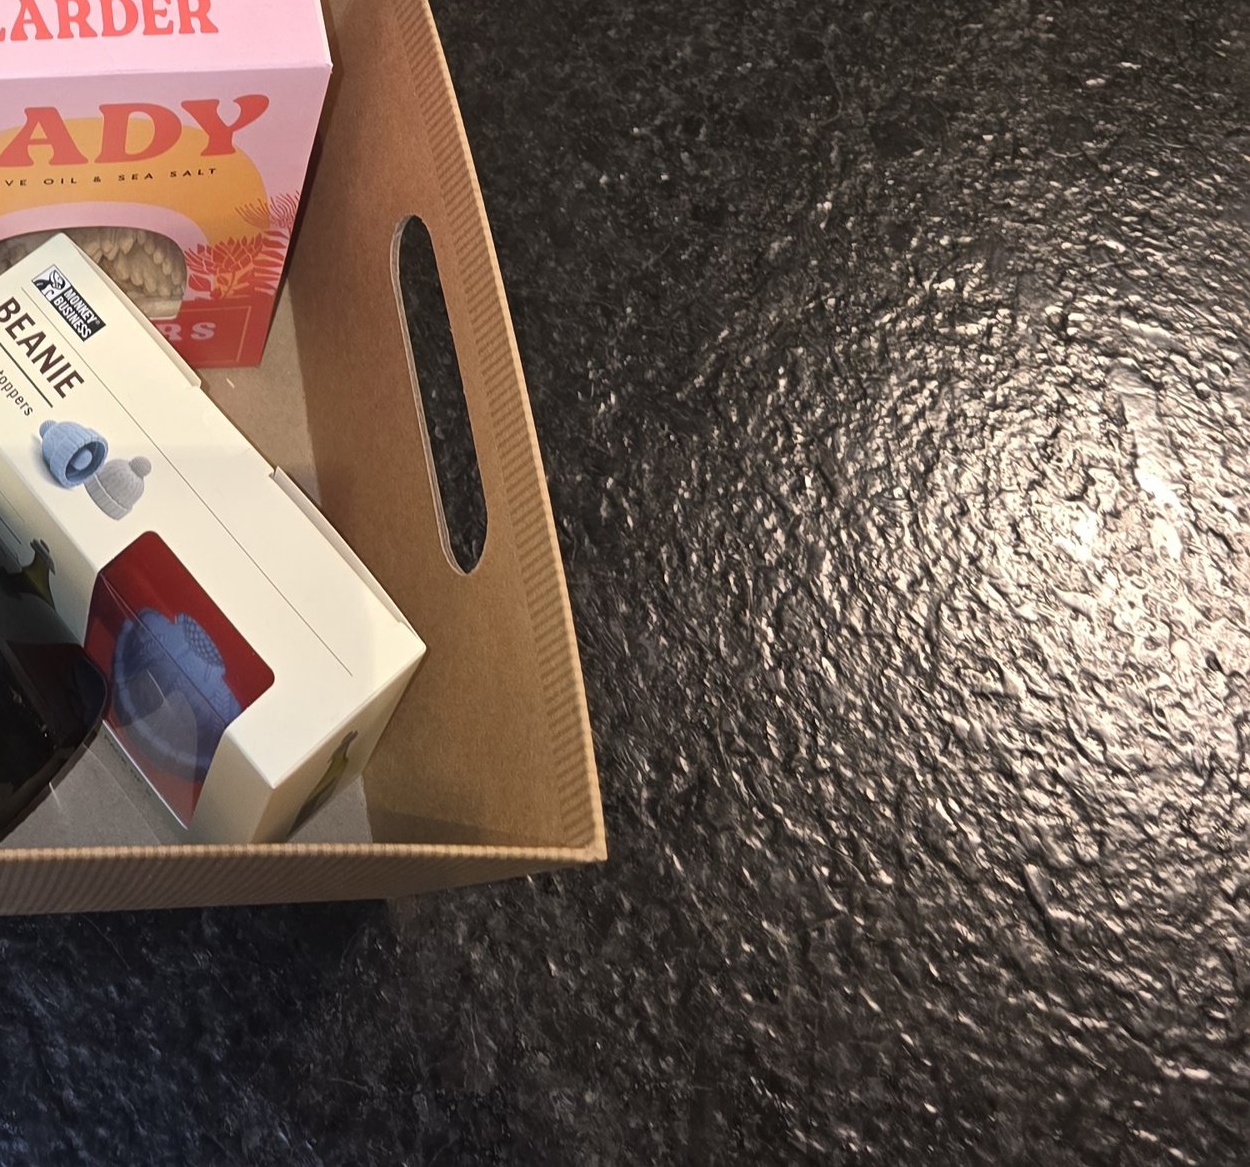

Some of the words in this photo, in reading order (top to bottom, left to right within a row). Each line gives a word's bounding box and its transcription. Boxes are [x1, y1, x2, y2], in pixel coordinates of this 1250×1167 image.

[43, 177, 77, 186] OIL
[92, 175, 102, 184] &
[117, 172, 154, 182] SEA
[169, 167, 217, 178] SALT
[53, 295, 91, 338] BUSINESS
